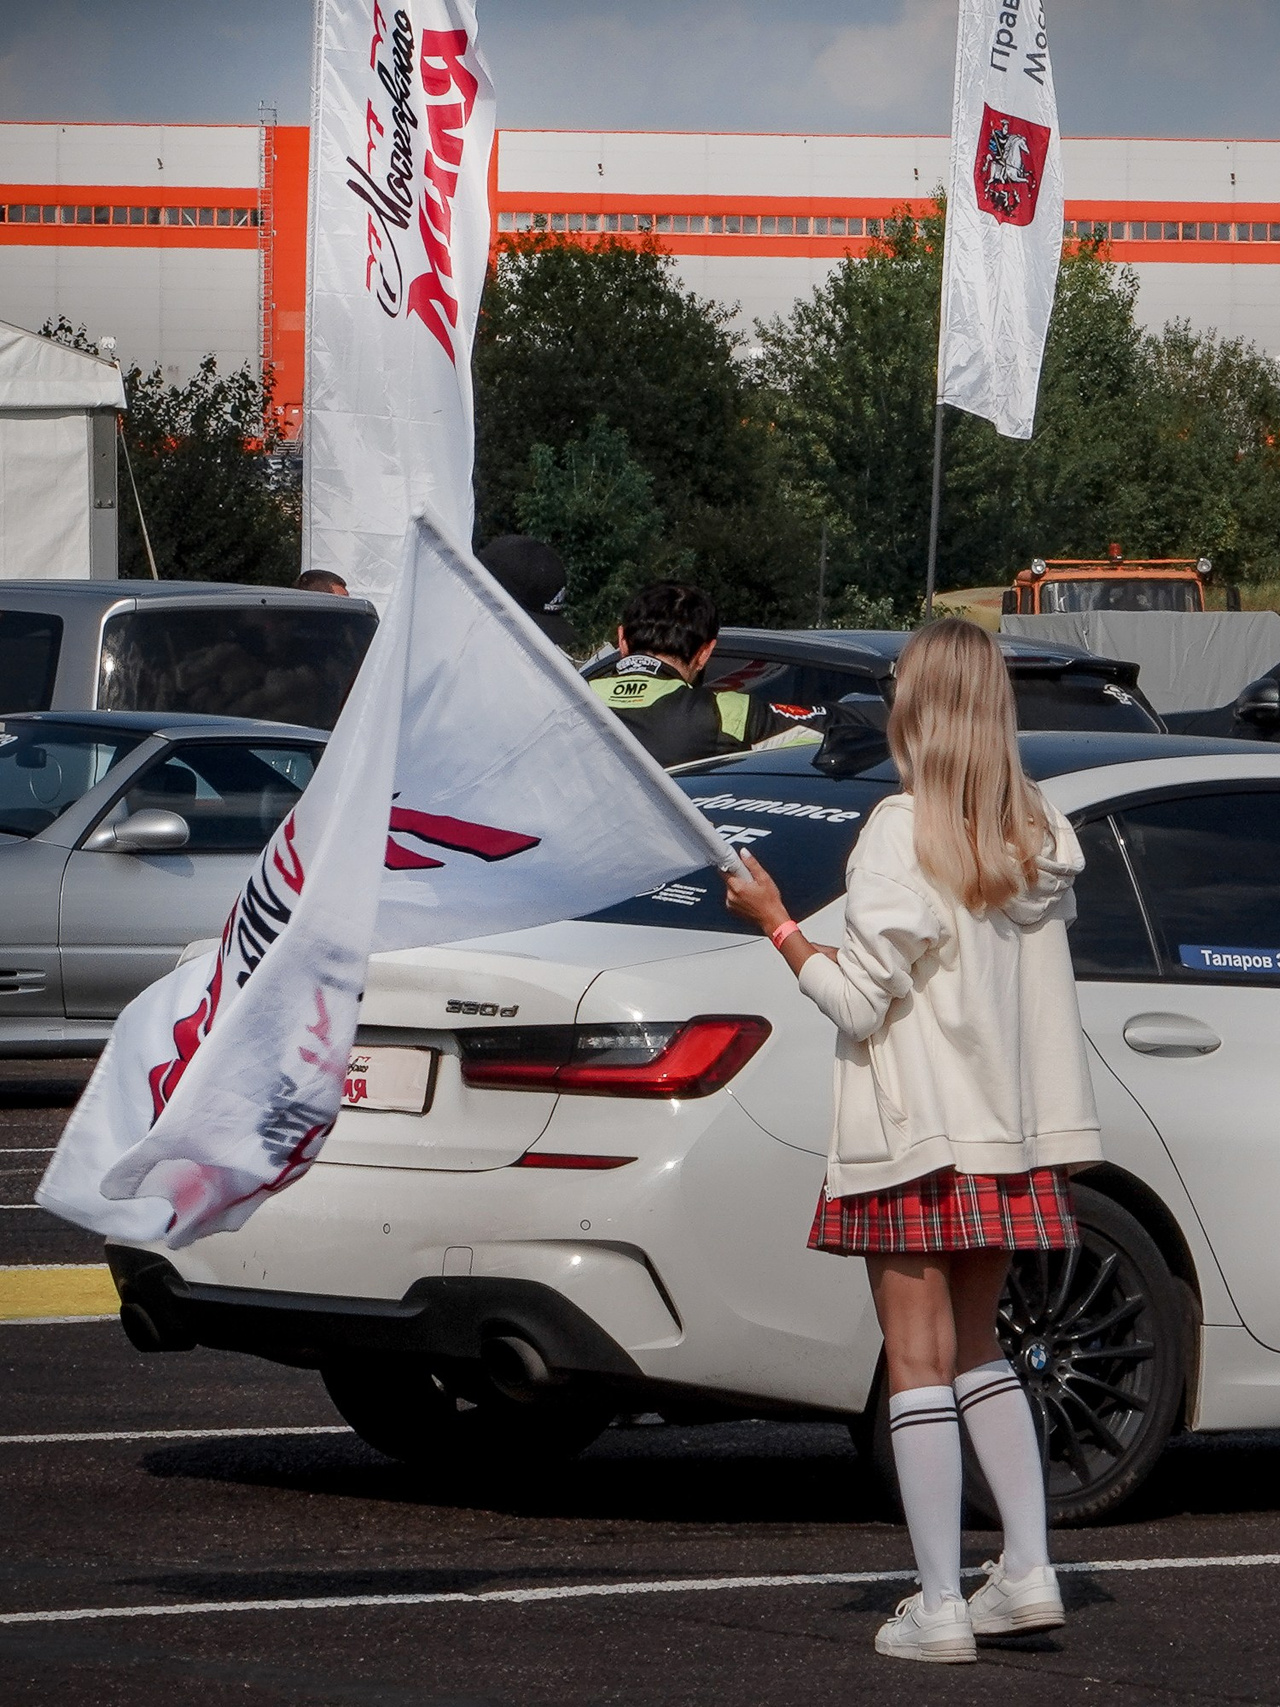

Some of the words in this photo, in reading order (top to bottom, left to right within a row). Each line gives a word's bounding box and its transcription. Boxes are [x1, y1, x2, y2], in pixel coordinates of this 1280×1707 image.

[613, 683, 648, 695] OMP
[1201, 950, 1273, 971] Таларов
[446, 999, 519, 1017] 330d
